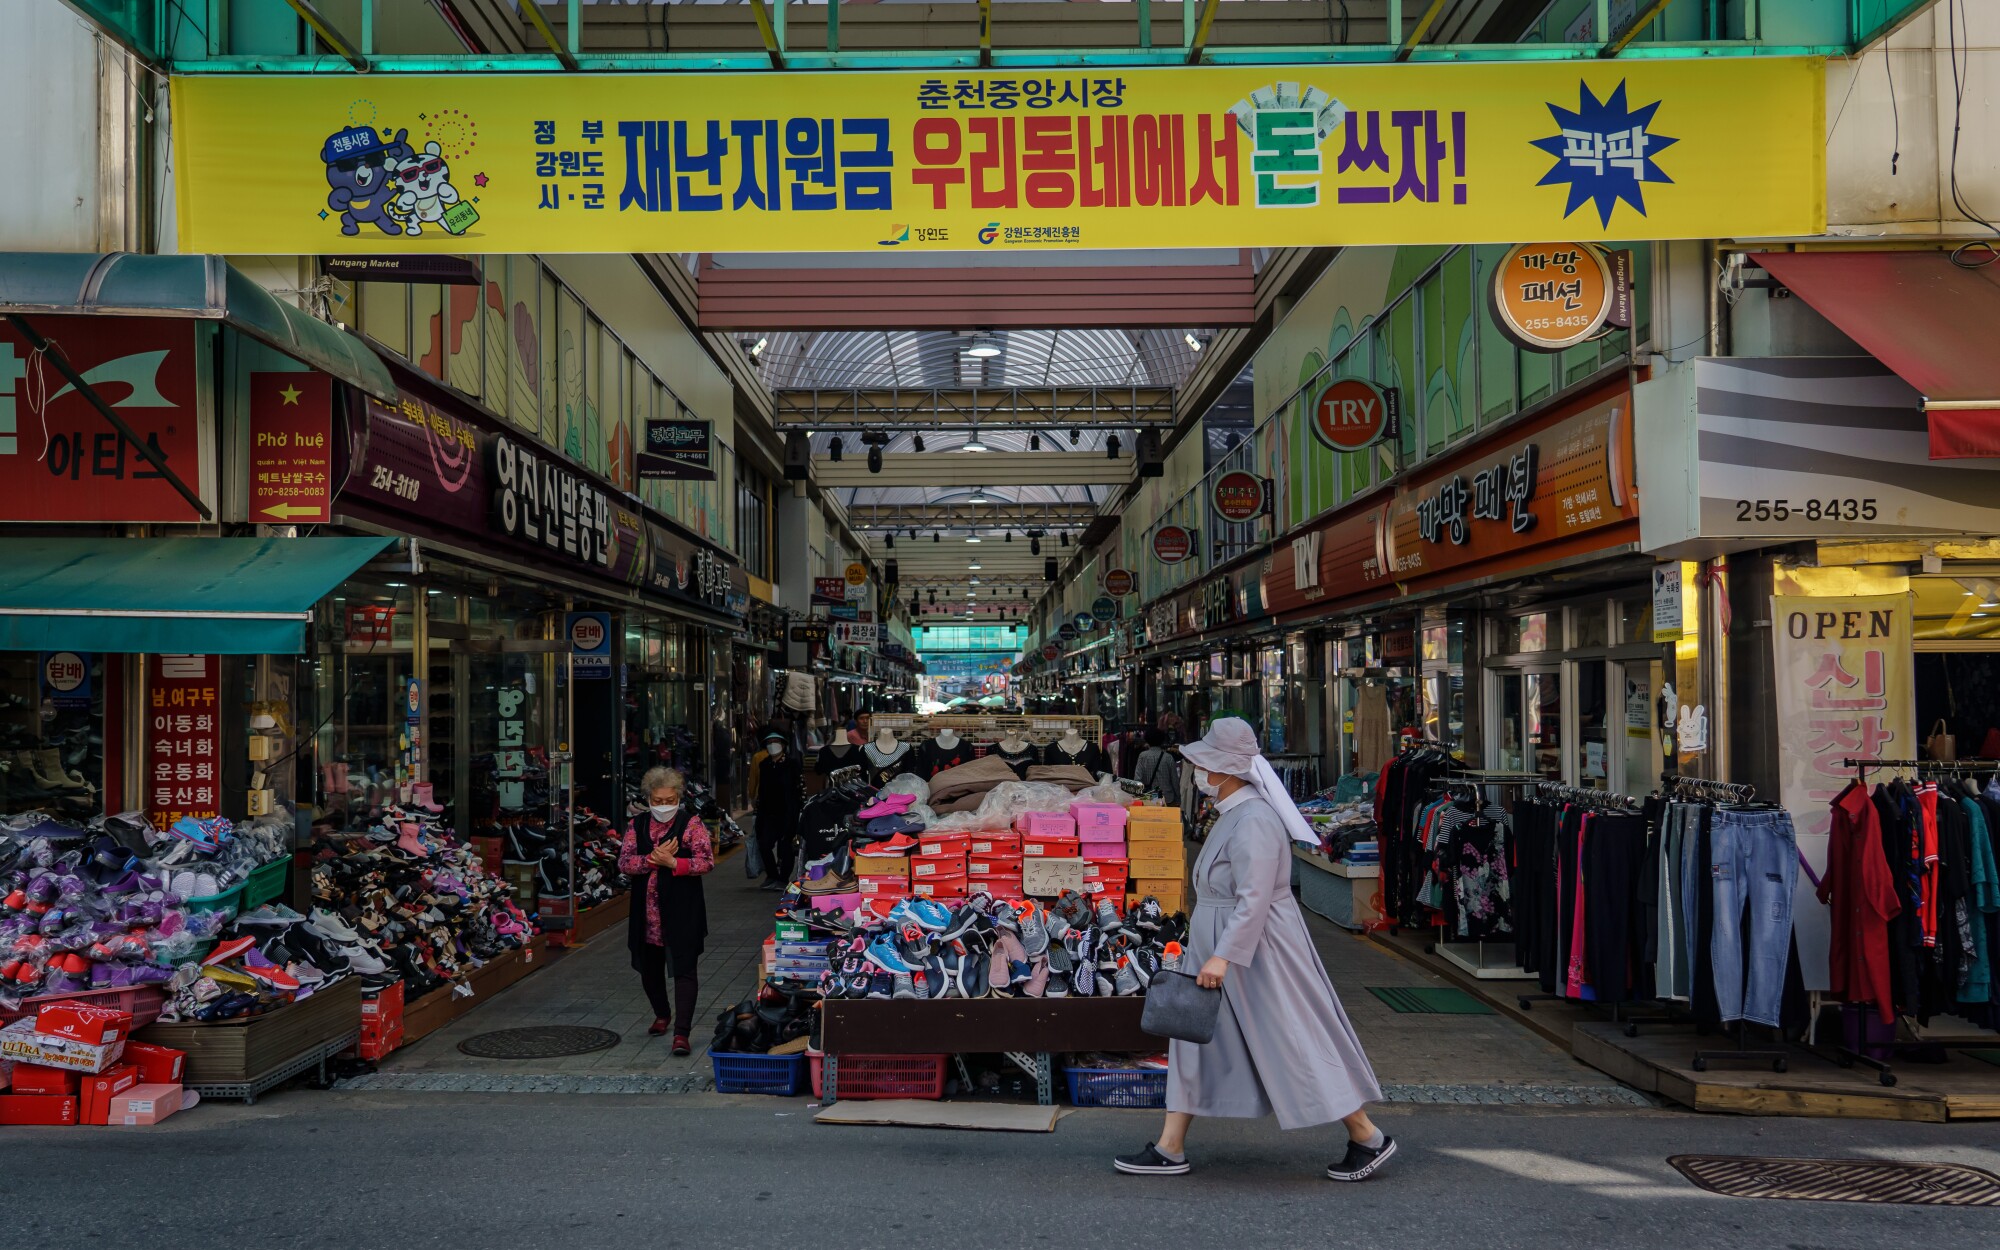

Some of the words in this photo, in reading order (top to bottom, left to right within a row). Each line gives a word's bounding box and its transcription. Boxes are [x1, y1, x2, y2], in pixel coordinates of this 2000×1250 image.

[916, 78, 1126, 110] 춘천중앙시장
[332, 131, 370, 153] 전통시장
[618, 117, 893, 212] 재난지원금
[911, 113, 1241, 209] 우리동네에서
[1251, 108, 1322, 208] 돈
[1337, 110, 1468, 205] 쓰자!
[1562, 125, 1650, 181] 팍팍
[534, 151, 605, 177] 강원도
[448, 206, 475, 229] 우리동네
[915, 227, 949, 242] 강원도
[1003, 225, 1080, 240] 강원도경제진흥원
[329, 258, 368, 271] Jungang
[370, 259, 400, 269] Market
[1519, 251, 1582, 274] 까망
[1617, 255, 1625, 292] Jungang
[1520, 279, 1582, 312] 패션
[1619, 293, 1627, 322] Market
[1526, 315, 1588, 330] 255-8435
[1323, 398, 1376, 426] TRY
[257, 431, 288, 447] Phở
[295, 431, 324, 448] huệ
[652, 426, 705, 445] 평화고무
[47, 431, 169, 482] 아티스
[258, 471, 325, 484] 베트남쌀국수
[371, 465, 420, 502] 254-3118
[258, 487, 325, 497] 070-8258-0083
[1735, 498, 1879, 522] 255-8435
[1291, 530, 1322, 590] TRY
[575, 625, 600, 638] 담배
[851, 624, 877, 638] 화장실
[1788, 610, 1893, 640] OPEN
[50, 663, 81, 678] 담배
[573, 657, 603, 665] KTRA
[152, 687, 215, 708] 남.여구두
[155, 715, 213, 733] 아동화
[155, 738, 213, 757] 숙녀화
[155, 762, 213, 781] 운동화
[155, 787, 213, 805] 등산화
[1031, 863, 1080, 878] 무조건
[2, 1041, 41, 1055] ULTRA
[1349, 1163, 1375, 1180] crocs
